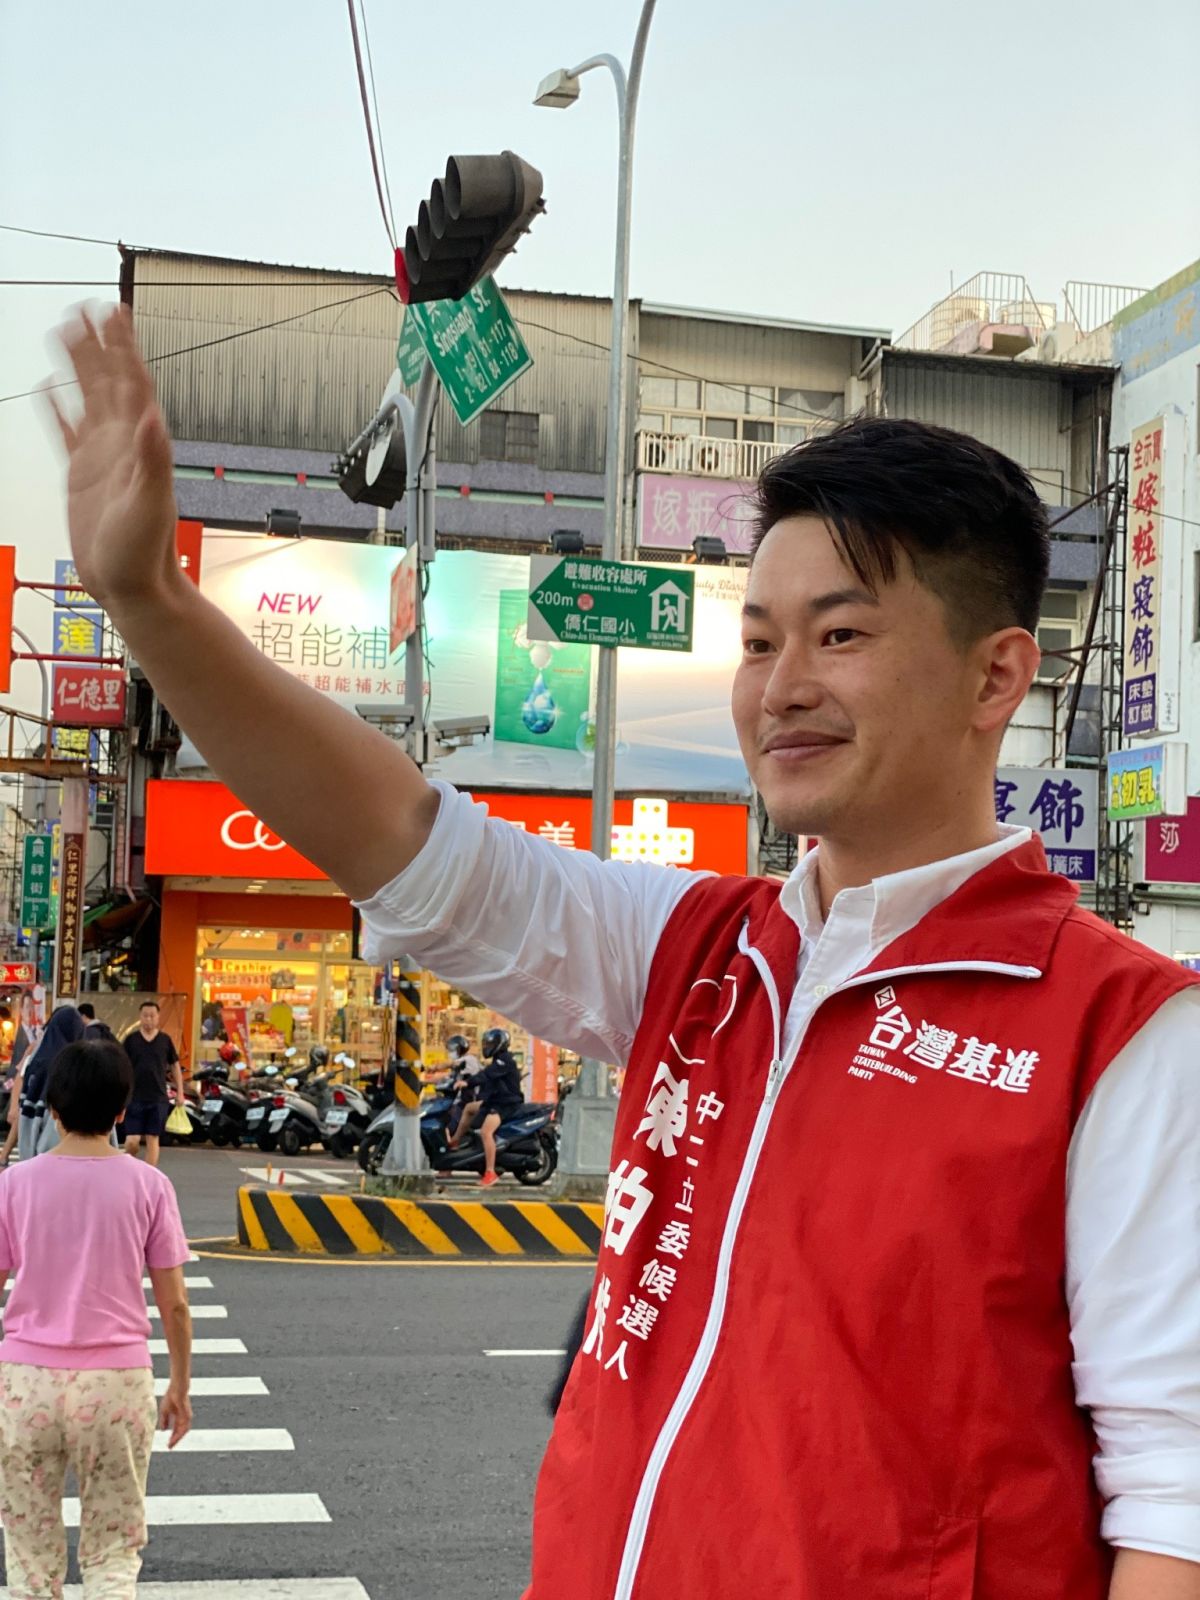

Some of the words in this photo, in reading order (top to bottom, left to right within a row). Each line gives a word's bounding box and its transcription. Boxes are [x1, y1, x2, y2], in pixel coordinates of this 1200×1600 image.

[433, 306, 476, 357] Singsiang
[536, 590, 574, 606] 200m
[572, 581, 611, 592] Evacuation
[613, 585, 638, 595] Shelter
[257, 592, 322, 615] NEW
[564, 613, 636, 635] 僑仁國小
[57, 677, 122, 711] 仁德里
[1128, 679, 1154, 702] 床墊
[1128, 703, 1153, 725] 訂做
[1121, 766, 1155, 808] 初乳
[1160, 822, 1180, 853] 莎
[226, 962, 272, 971] Cashier
[858, 1043, 887, 1059] TAIWAN
[868, 1005, 1040, 1093] 台灣基進
[848, 1066, 875, 1081] PARTY
[852, 1055, 918, 1084] STATEBUILDING
